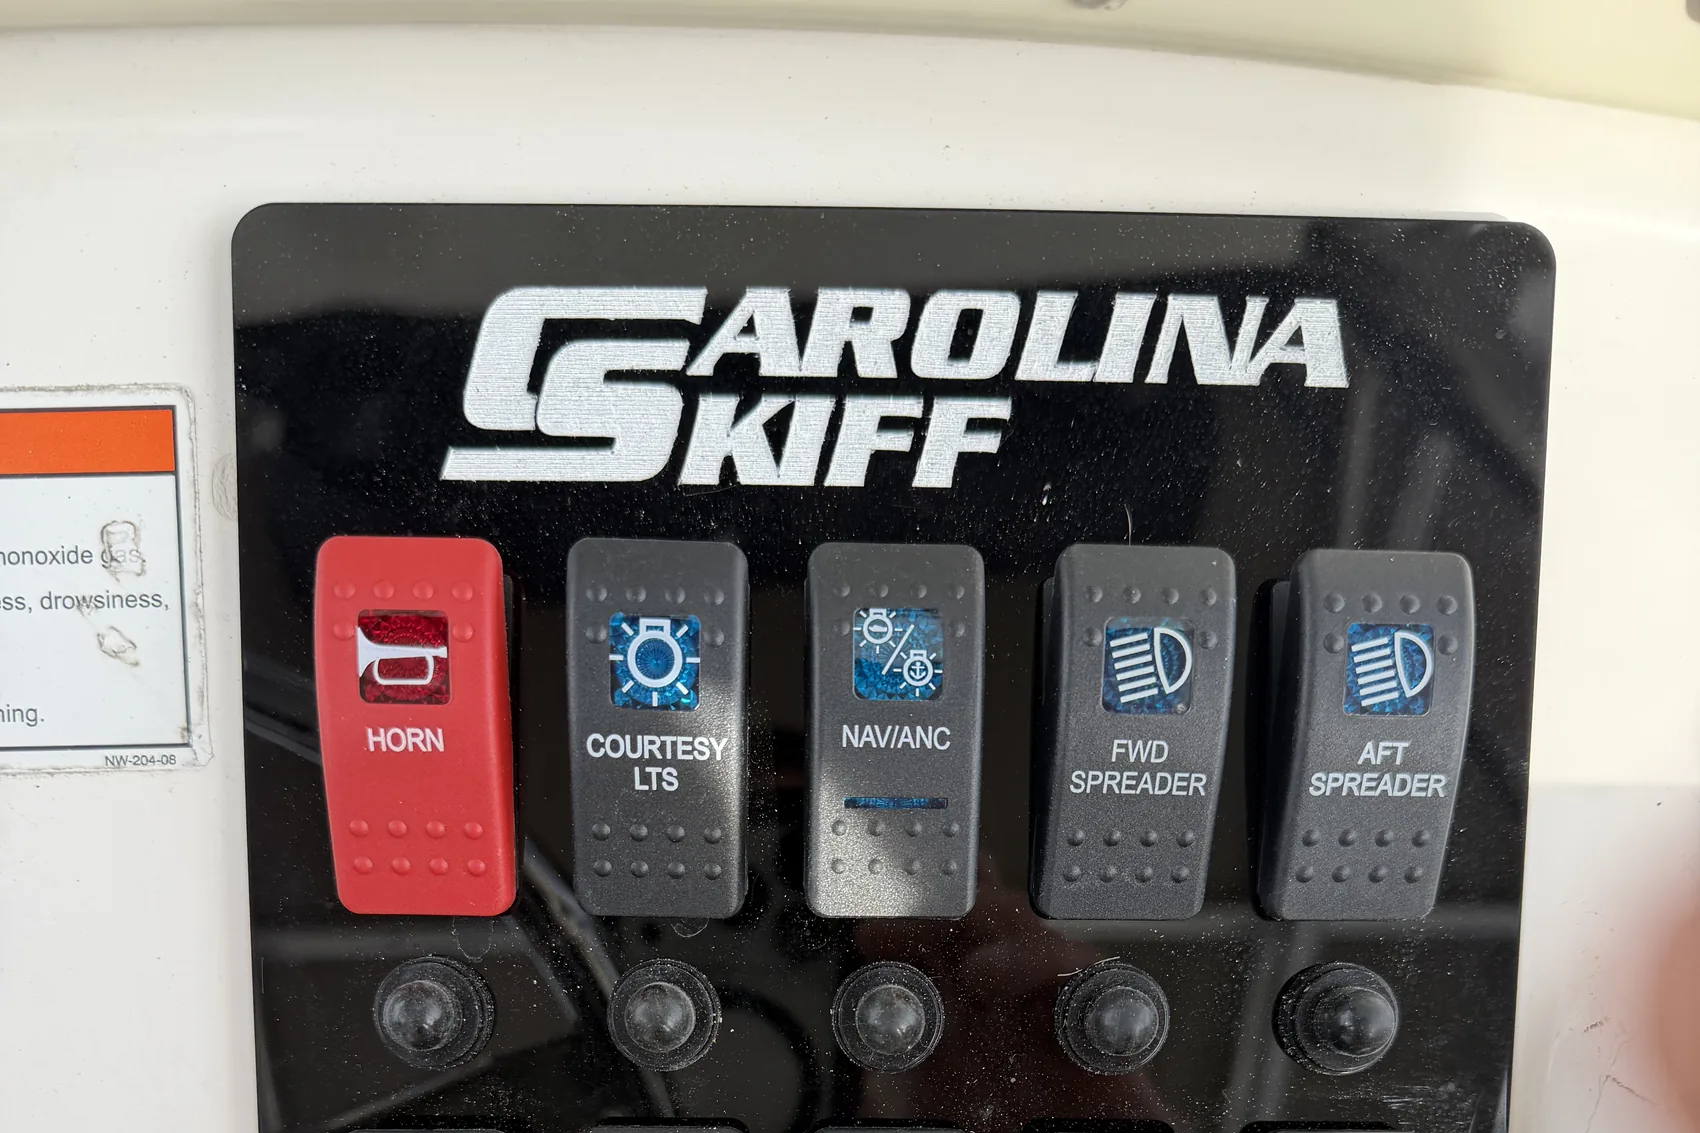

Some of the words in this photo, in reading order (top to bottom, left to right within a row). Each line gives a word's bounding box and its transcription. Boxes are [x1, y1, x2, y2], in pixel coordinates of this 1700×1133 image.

[463, 286, 1350, 432] CAROLINA
[440, 338, 1012, 488] SKIFF
[0, 595, 33, 613] ss,
[40, 590, 169, 611] drowsiness,
[366, 727, 445, 753] HORN
[586, 733, 729, 762] COURTESY
[841, 724, 952, 751] NAV/ANC
[105, 755, 176, 766] NW-204-08
[1111, 739, 1169, 763] FWD
[1357, 741, 1409, 766] AFT
[634, 767, 679, 791] LTS
[1069, 770, 1207, 797] SPREADER
[1308, 772, 1447, 798] SPREADER
